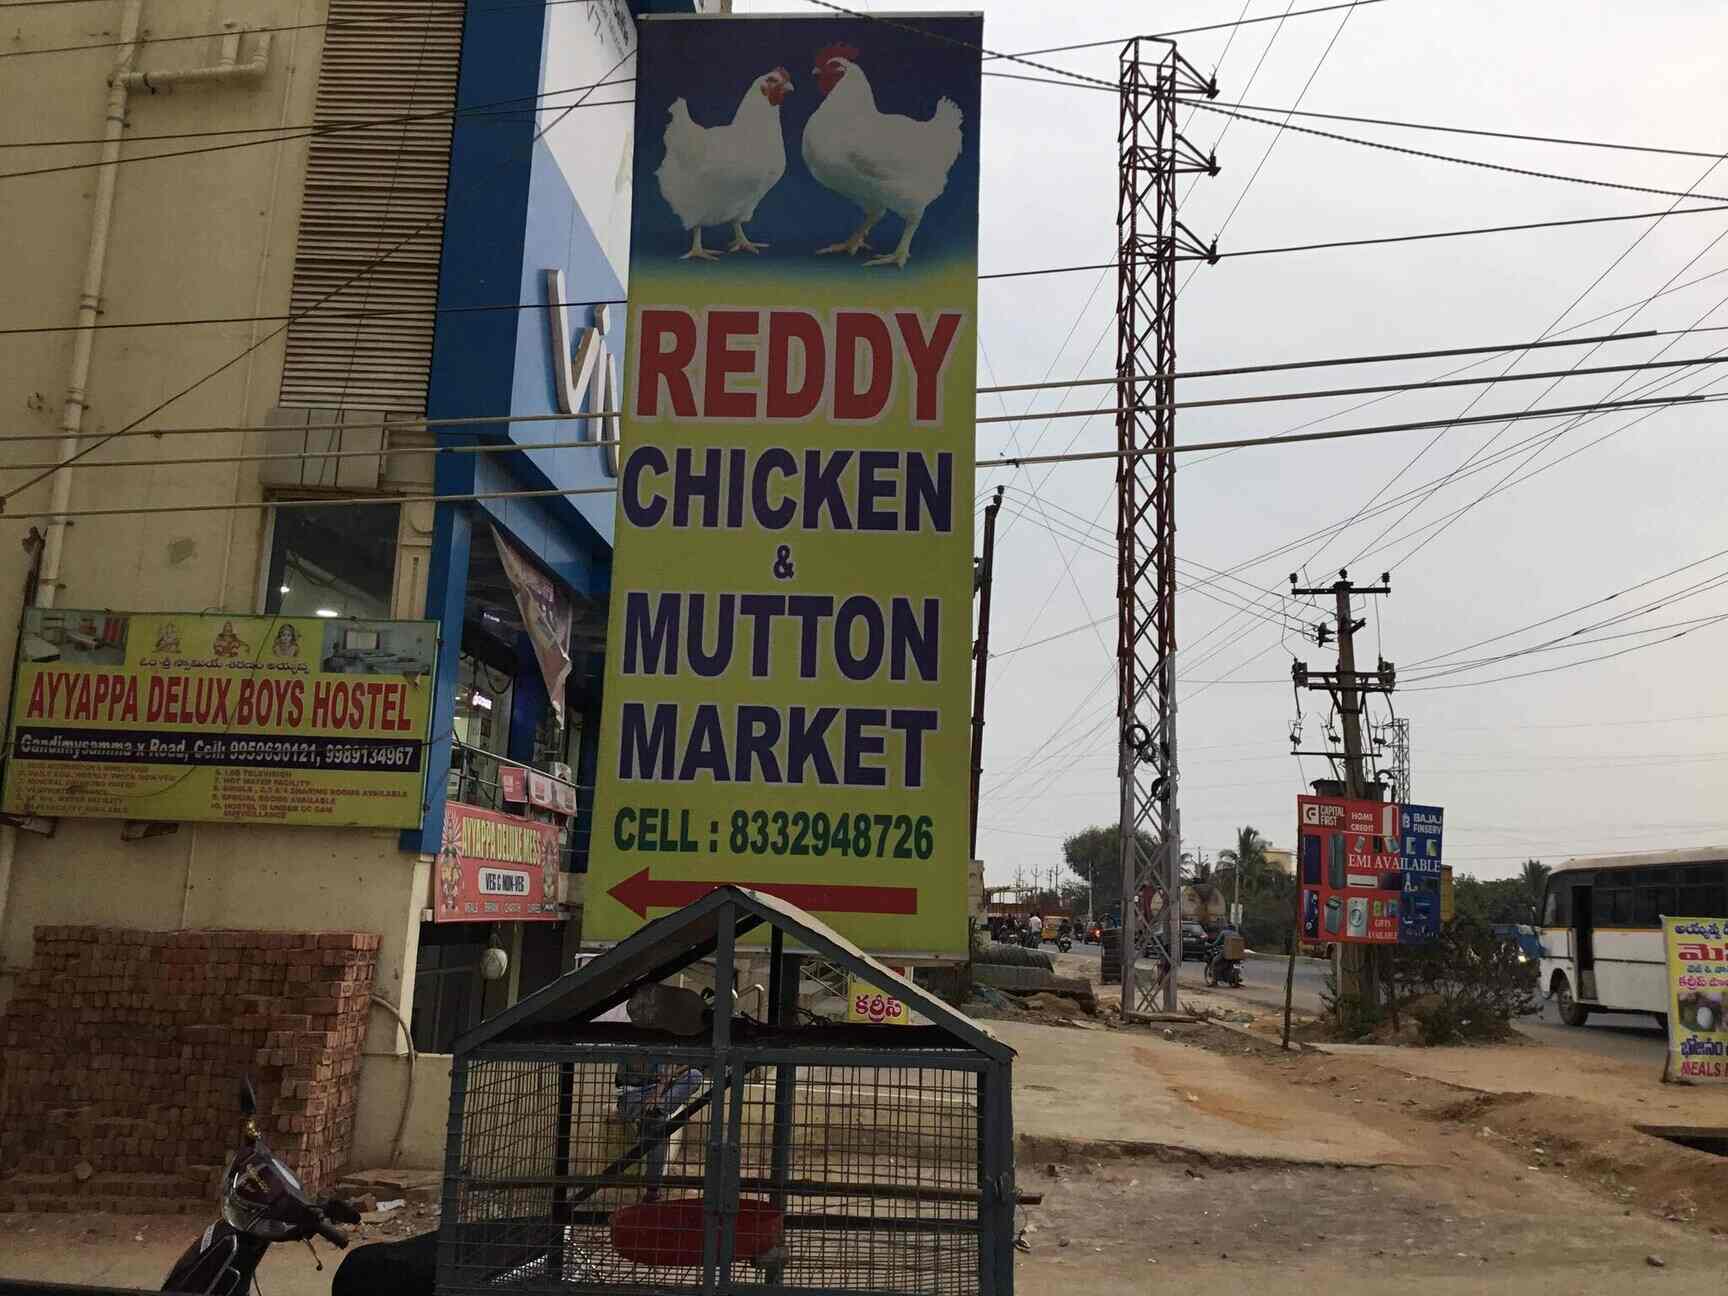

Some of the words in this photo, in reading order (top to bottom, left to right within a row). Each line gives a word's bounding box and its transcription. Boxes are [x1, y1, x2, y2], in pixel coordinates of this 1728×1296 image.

[633, 307, 965, 424] REDDY
[622, 445, 954, 533] CHICKEN
[773, 544, 794, 579] &
[622, 592, 941, 682] MUTTON
[26, 671, 138, 722] AYYAPPA
[146, 676, 232, 725] DELUX
[236, 678, 306, 728] BOYS
[311, 680, 411, 732] HOSTEL
[324, 742, 414, 766] 9989134967
[618, 702, 939, 788] MARKET
[614, 807, 698, 852] CELL
[729, 809, 934, 860] 8332948726
[1348, 854, 1372, 869] EMI
[1373, 855, 1441, 873] AVAILABLE
[1681, 1061, 1721, 1078] MEALS
